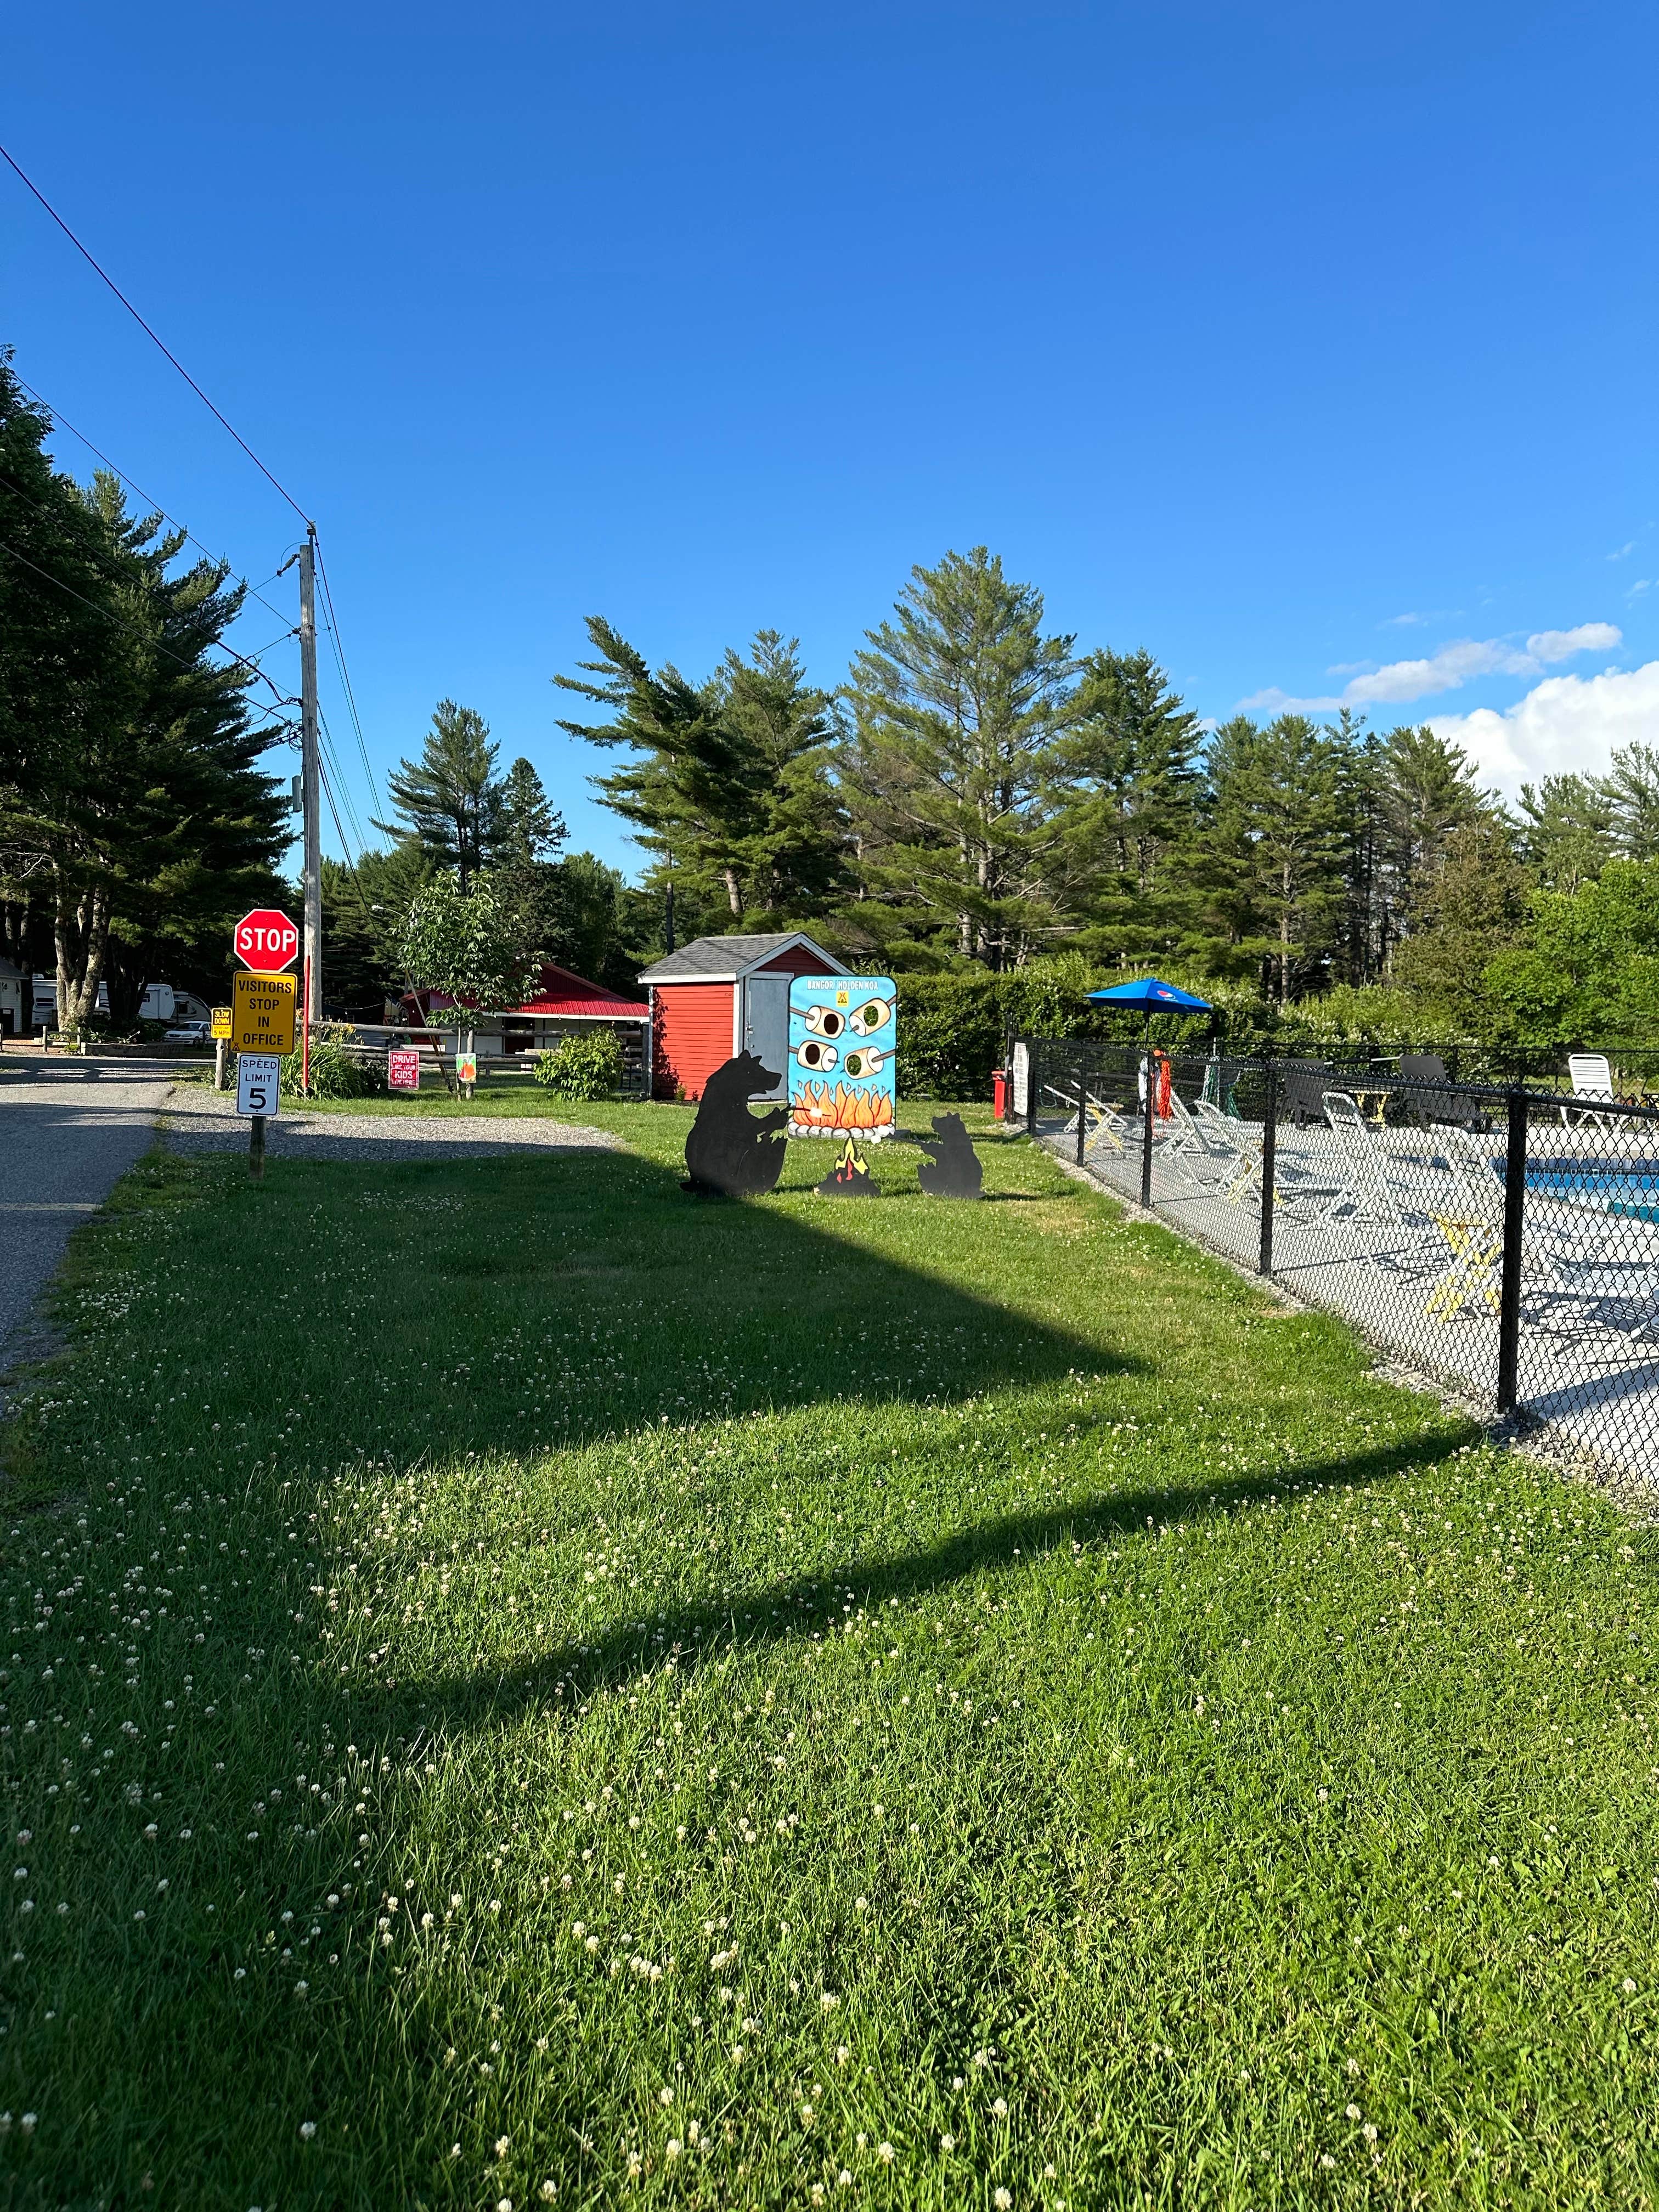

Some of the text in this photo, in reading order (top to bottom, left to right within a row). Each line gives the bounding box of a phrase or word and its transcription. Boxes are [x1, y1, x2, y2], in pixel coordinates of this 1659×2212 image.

[240, 927, 296, 952] STOP
[238, 980, 292, 994] VISITORS
[807, 980, 834, 990] BANGOR
[838, 980, 864, 990] HOLDEN
[864, 980, 878, 990] KOA
[249, 998, 280, 1010] STOP
[258, 1016, 269, 1028] IN
[243, 1032, 284, 1046] OFFICE
[242, 1059, 277, 1069] SPEED
[392, 1054, 415, 1063] DRIVE
[245, 1074, 273, 1082] LIMIT
[394, 1070, 413, 1079] KIDS
[249, 1087, 267, 1110] 5
